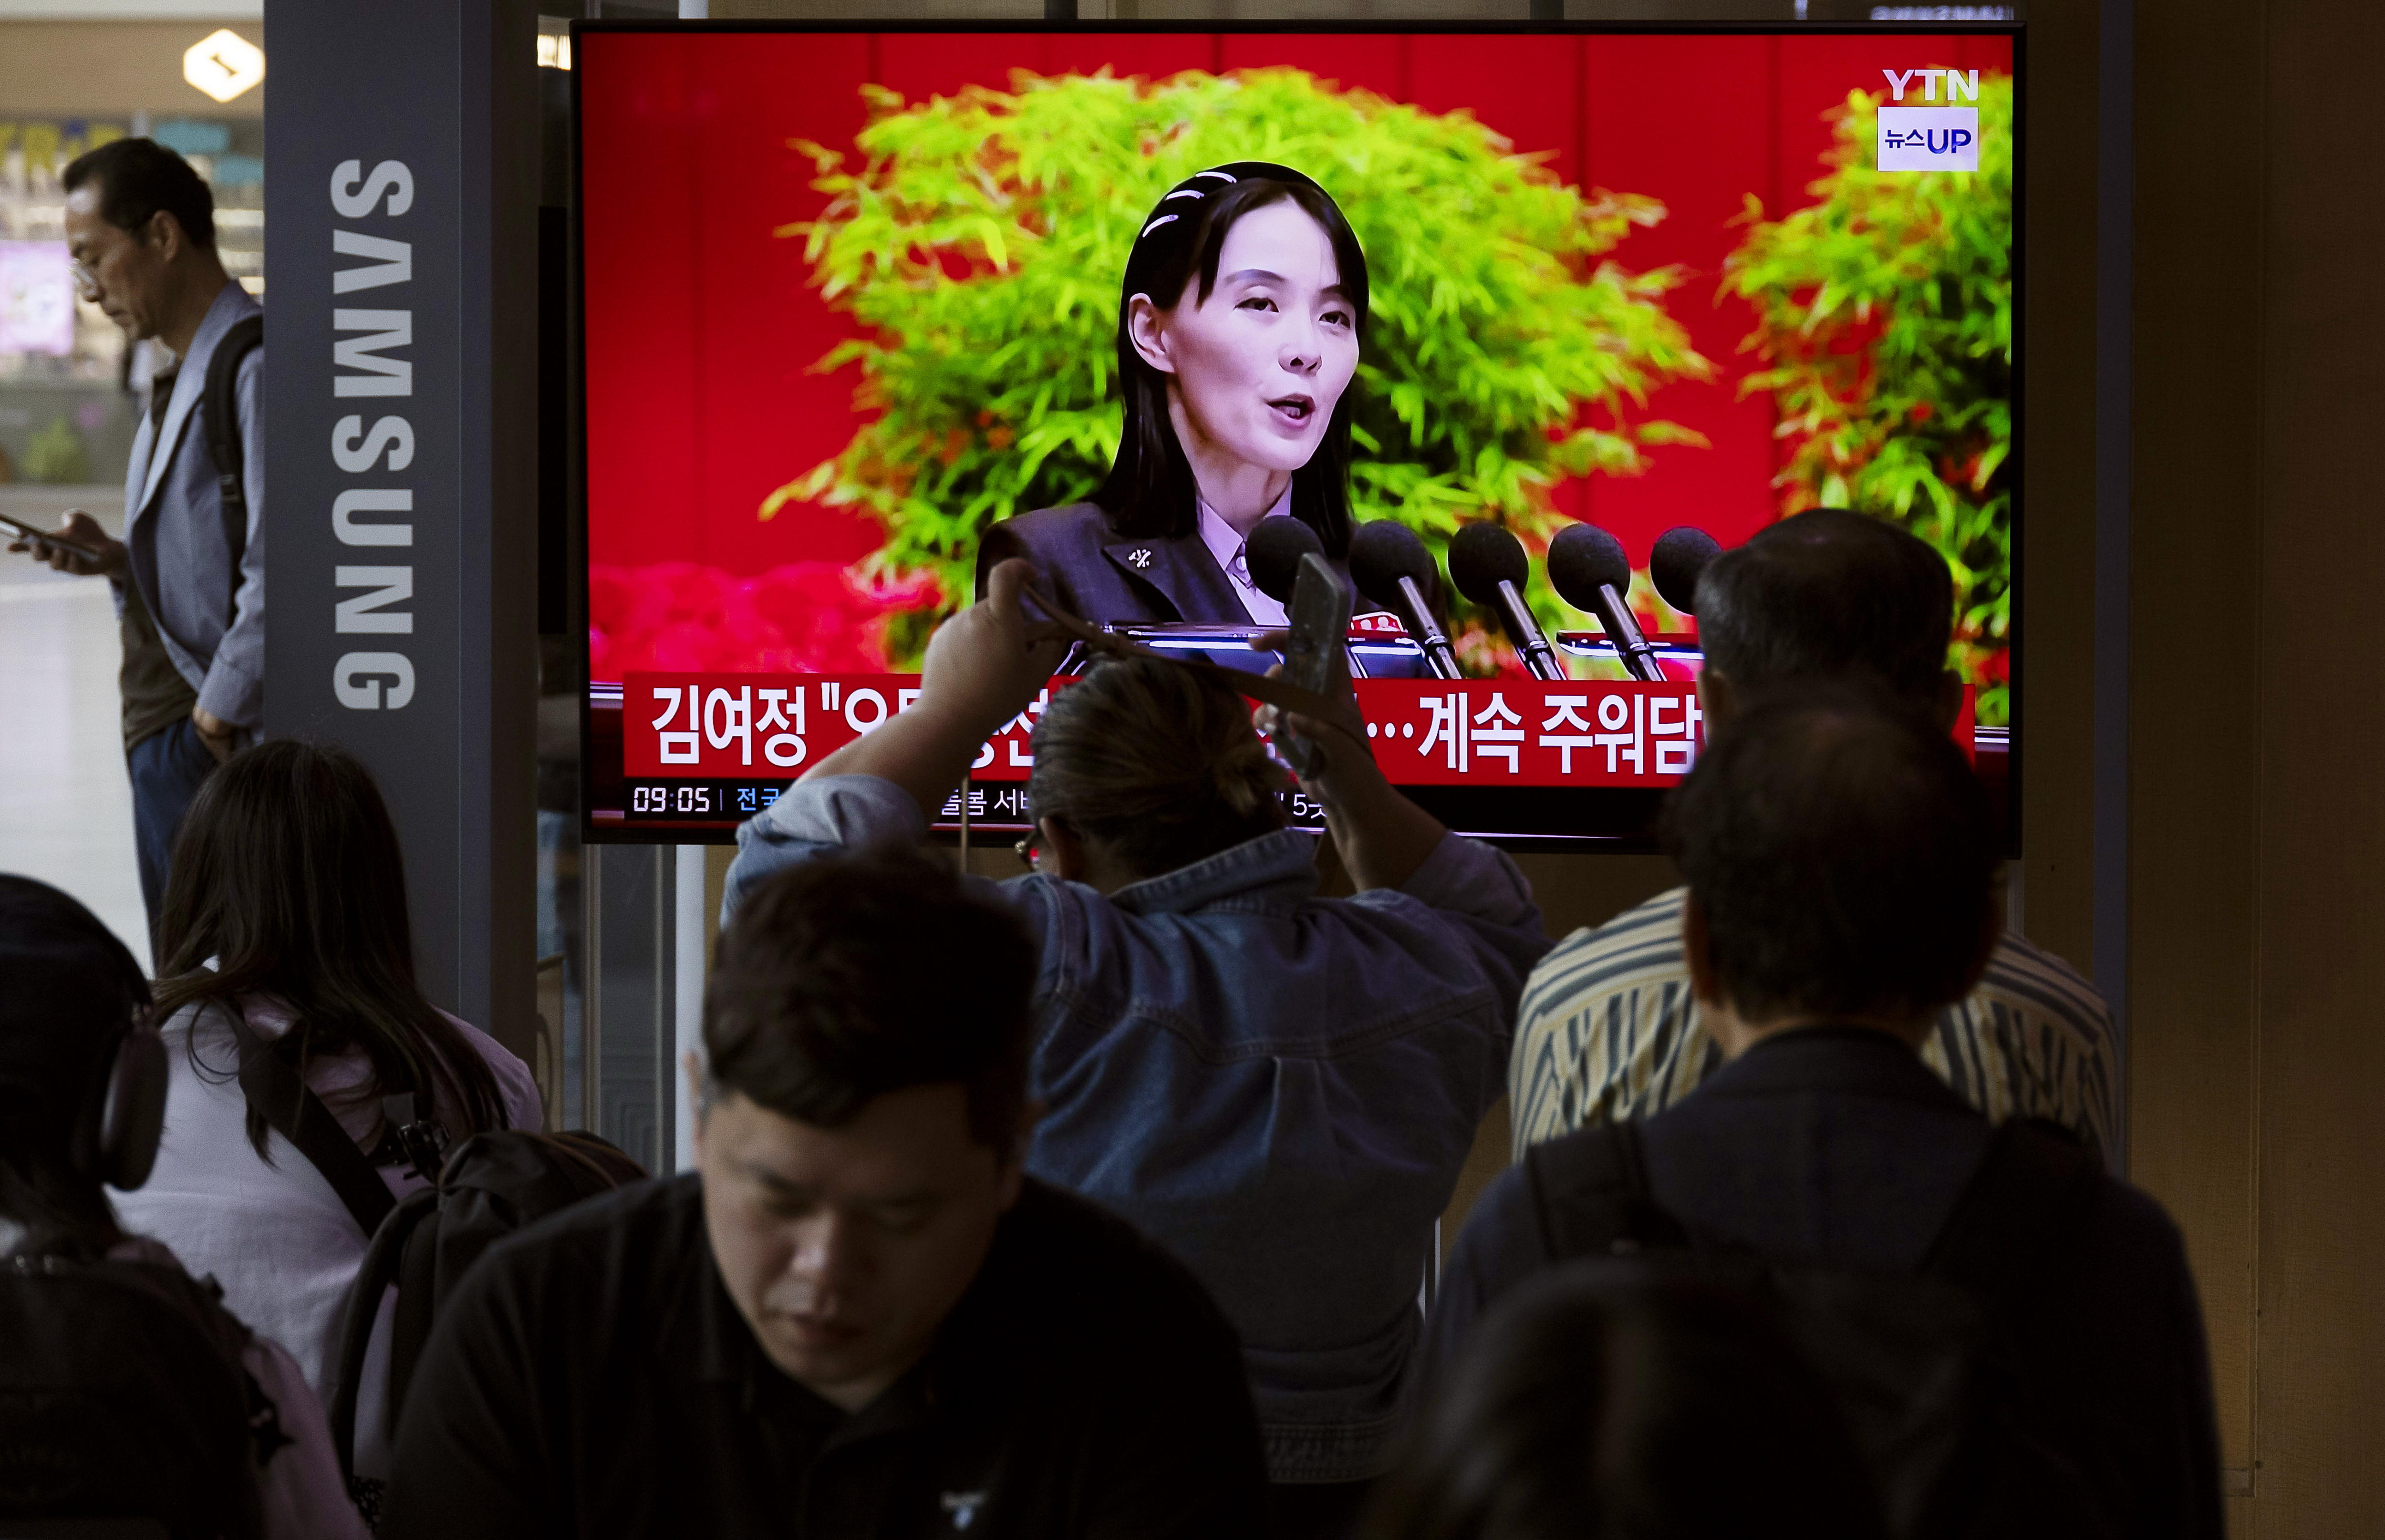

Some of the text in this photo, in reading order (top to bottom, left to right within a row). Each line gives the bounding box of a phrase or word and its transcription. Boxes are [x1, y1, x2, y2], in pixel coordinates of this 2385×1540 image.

[1882, 69, 1979, 101] YTN
[330, 159, 415, 710] SAMSUNG
[651, 684, 807, 767] 김여정
[633, 787, 710, 812] 09:05
